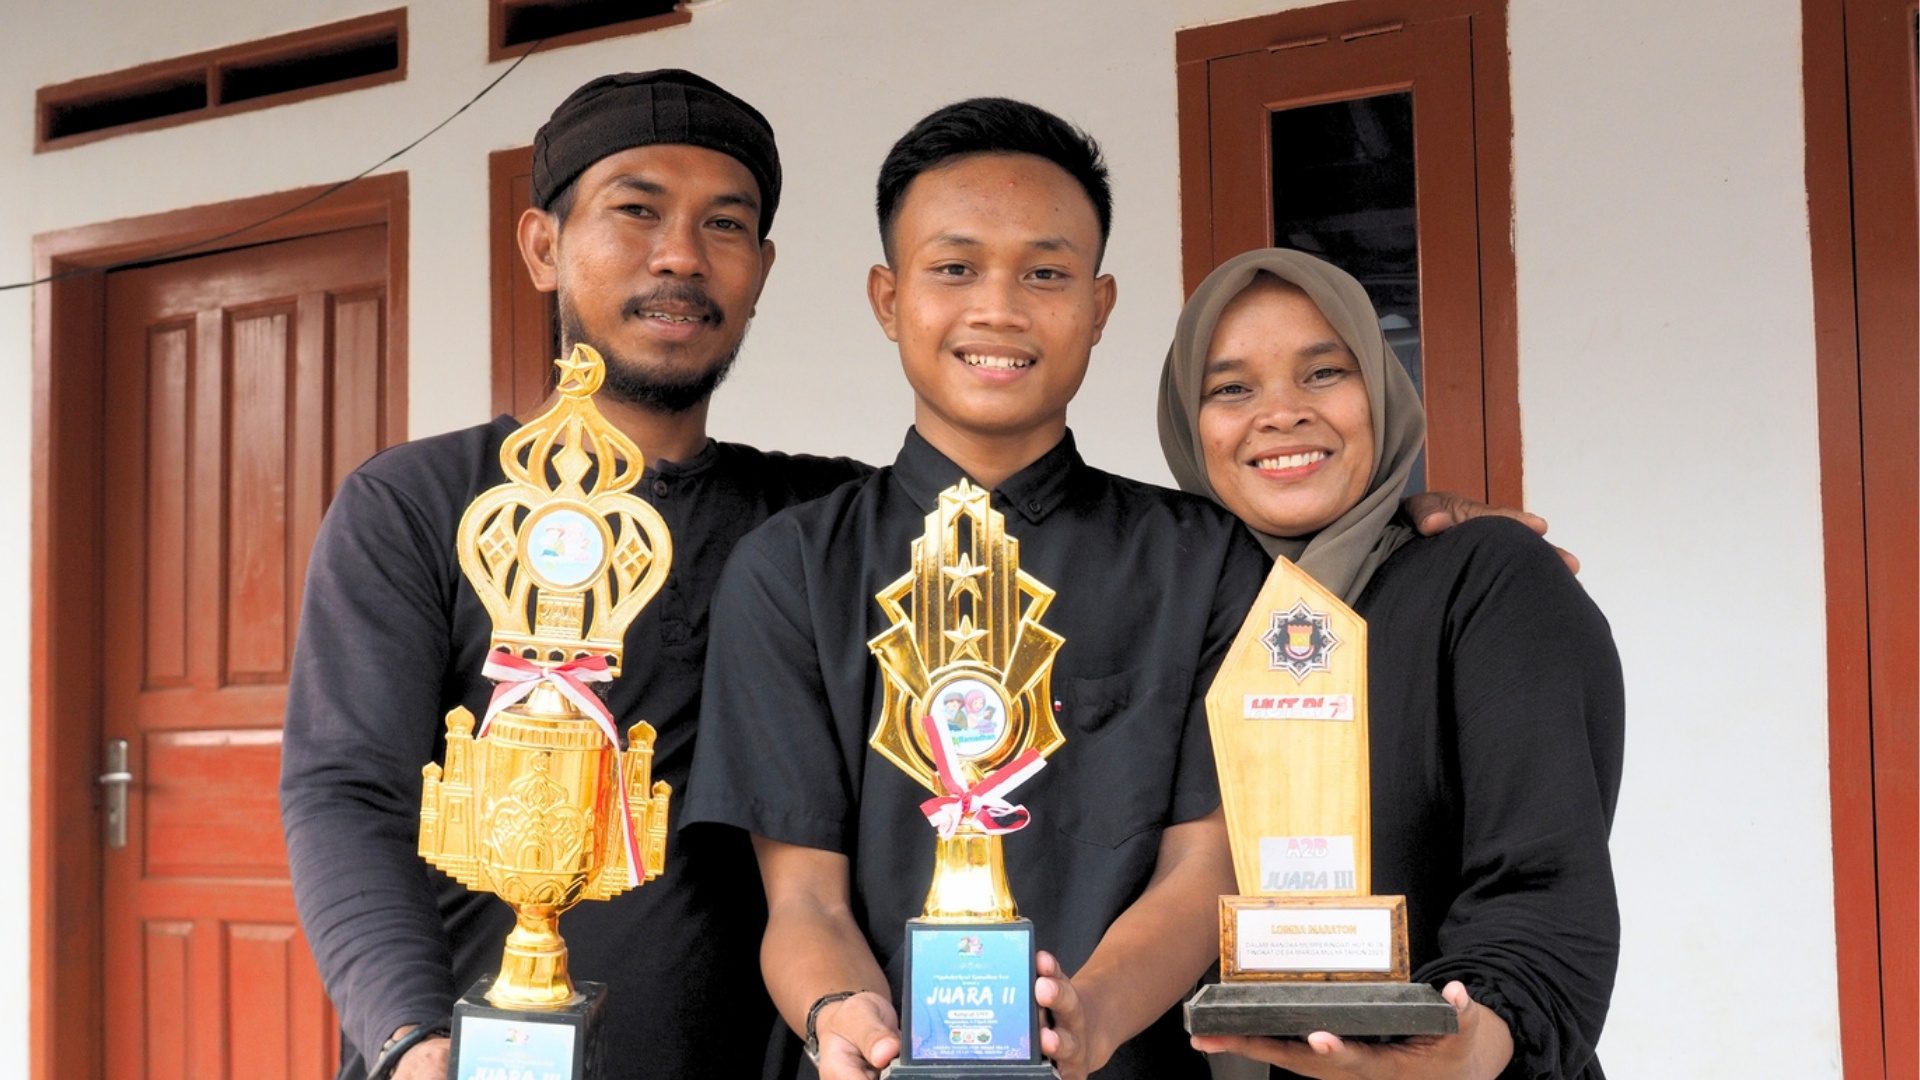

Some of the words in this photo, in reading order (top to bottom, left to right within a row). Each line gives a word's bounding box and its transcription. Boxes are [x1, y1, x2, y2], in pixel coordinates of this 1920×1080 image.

[1286, 838, 1328, 857] A2B
[1262, 871, 1328, 890] JUARA
[1333, 870, 1354, 890] III
[1271, 924, 1306, 935] LOMBA
[1308, 924, 1357, 935] MARATON
[925, 986, 993, 1006] JUARA
[1002, 986, 1016, 1005] II
